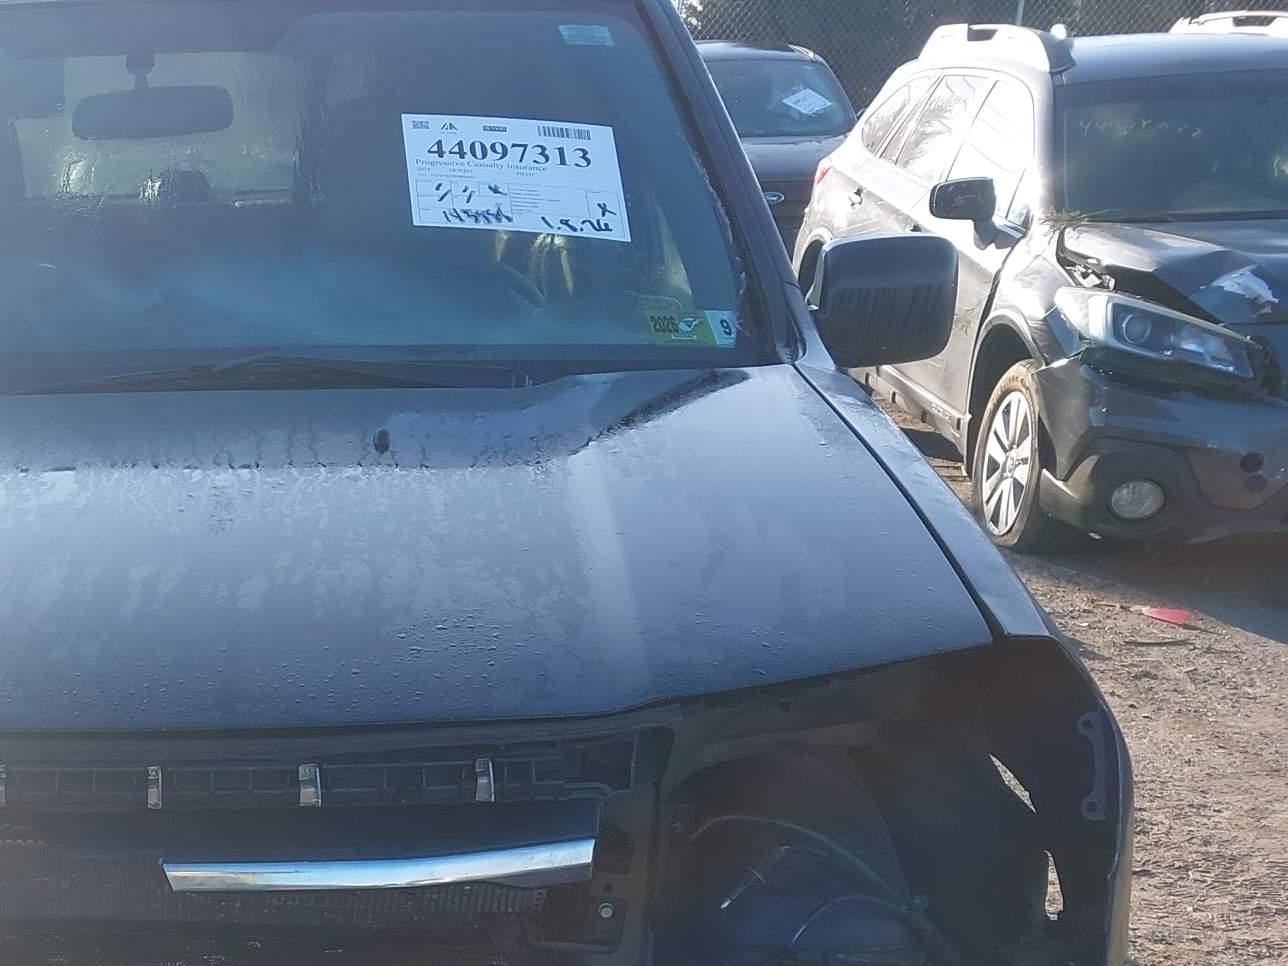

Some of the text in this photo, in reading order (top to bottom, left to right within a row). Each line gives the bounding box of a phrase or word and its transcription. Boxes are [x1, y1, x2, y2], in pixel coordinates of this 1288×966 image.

[427, 139, 592, 168] 44097313
[415, 158, 548, 172] Progressive Casualty Insurance
[719, 319, 732, 336] 9
